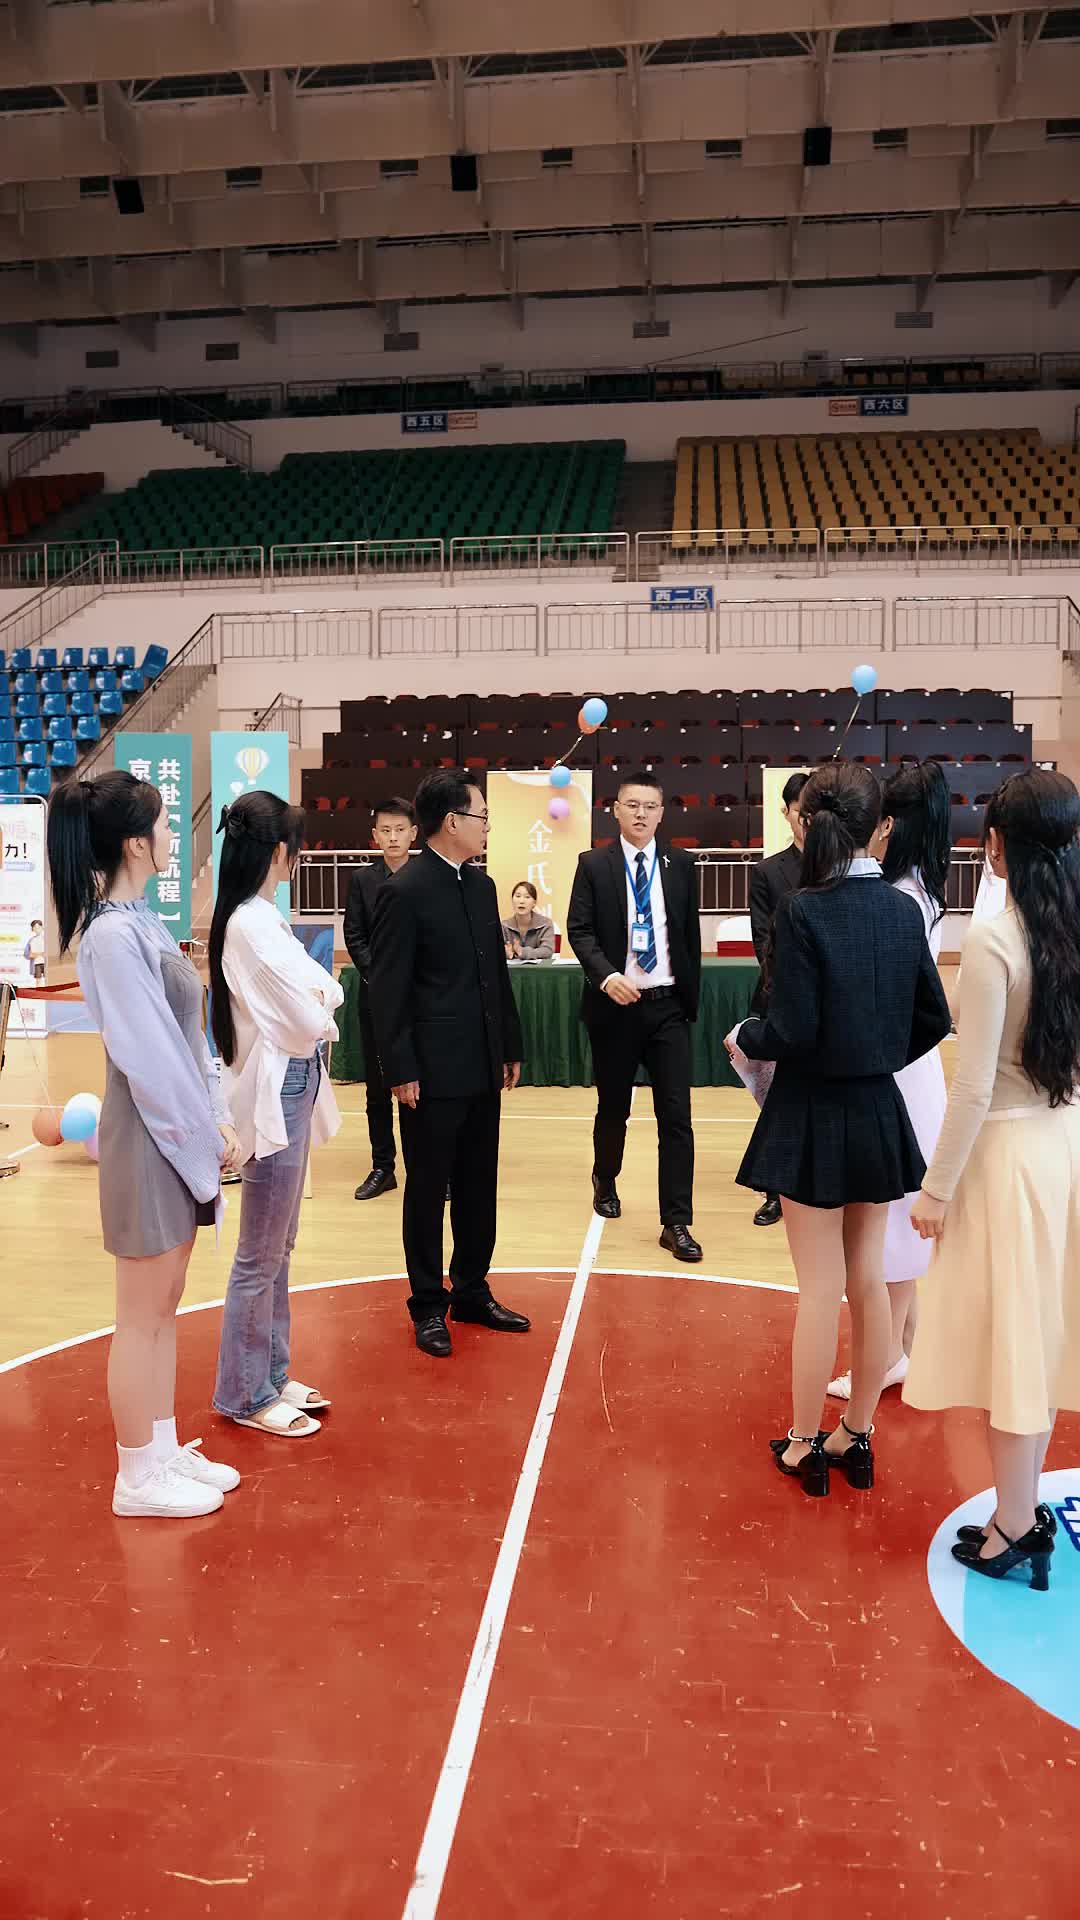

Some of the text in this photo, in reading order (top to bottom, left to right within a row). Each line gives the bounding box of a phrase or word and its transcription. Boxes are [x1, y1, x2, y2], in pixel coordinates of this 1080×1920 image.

[864, 399, 904, 410] 西六区
[406, 415, 444, 426] 西五区
[655, 588, 709, 602] 西二区
[527, 819, 552, 919] 金氏
